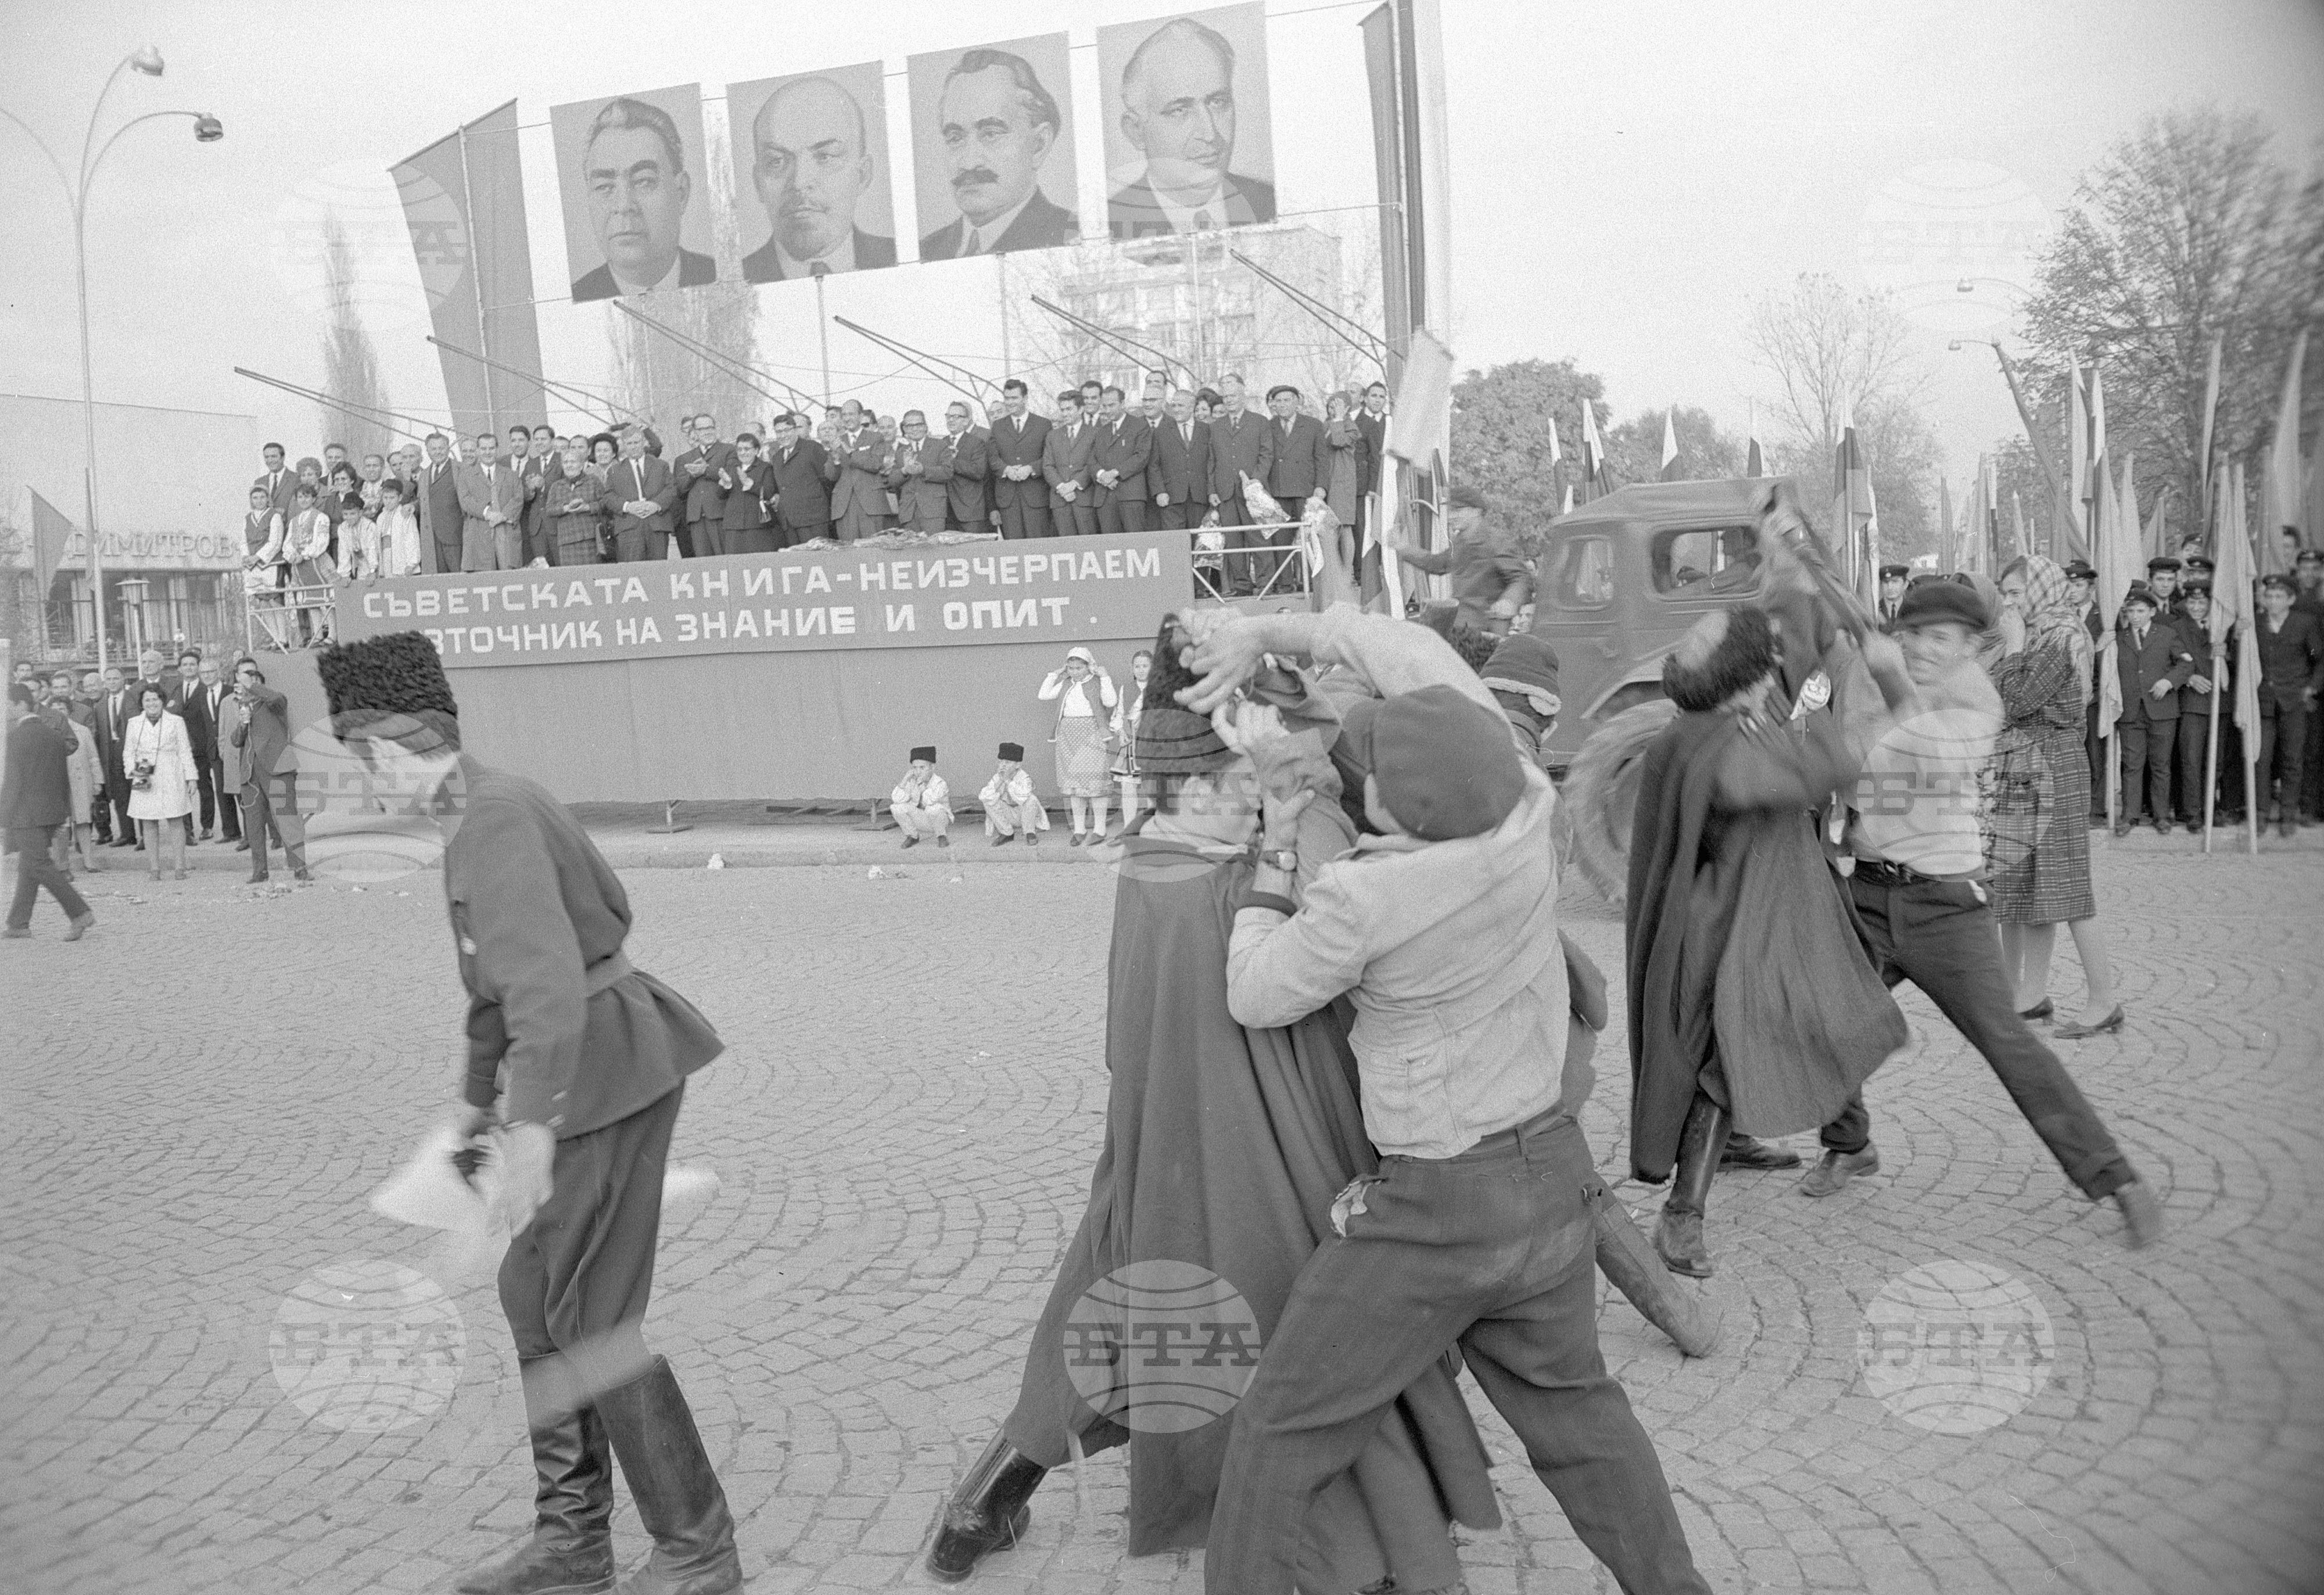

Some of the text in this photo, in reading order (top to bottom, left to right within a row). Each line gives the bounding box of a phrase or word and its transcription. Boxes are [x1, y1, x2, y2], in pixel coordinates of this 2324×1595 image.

[363, 577, 650, 618] СЪВЕТСКАТА
[397, 620, 602, 654] ЗТОЧНИК
[616, 616, 662, 645] НА
[675, 606, 856, 641] ЗНАНИЕ
[885, 604, 916, 632] И
